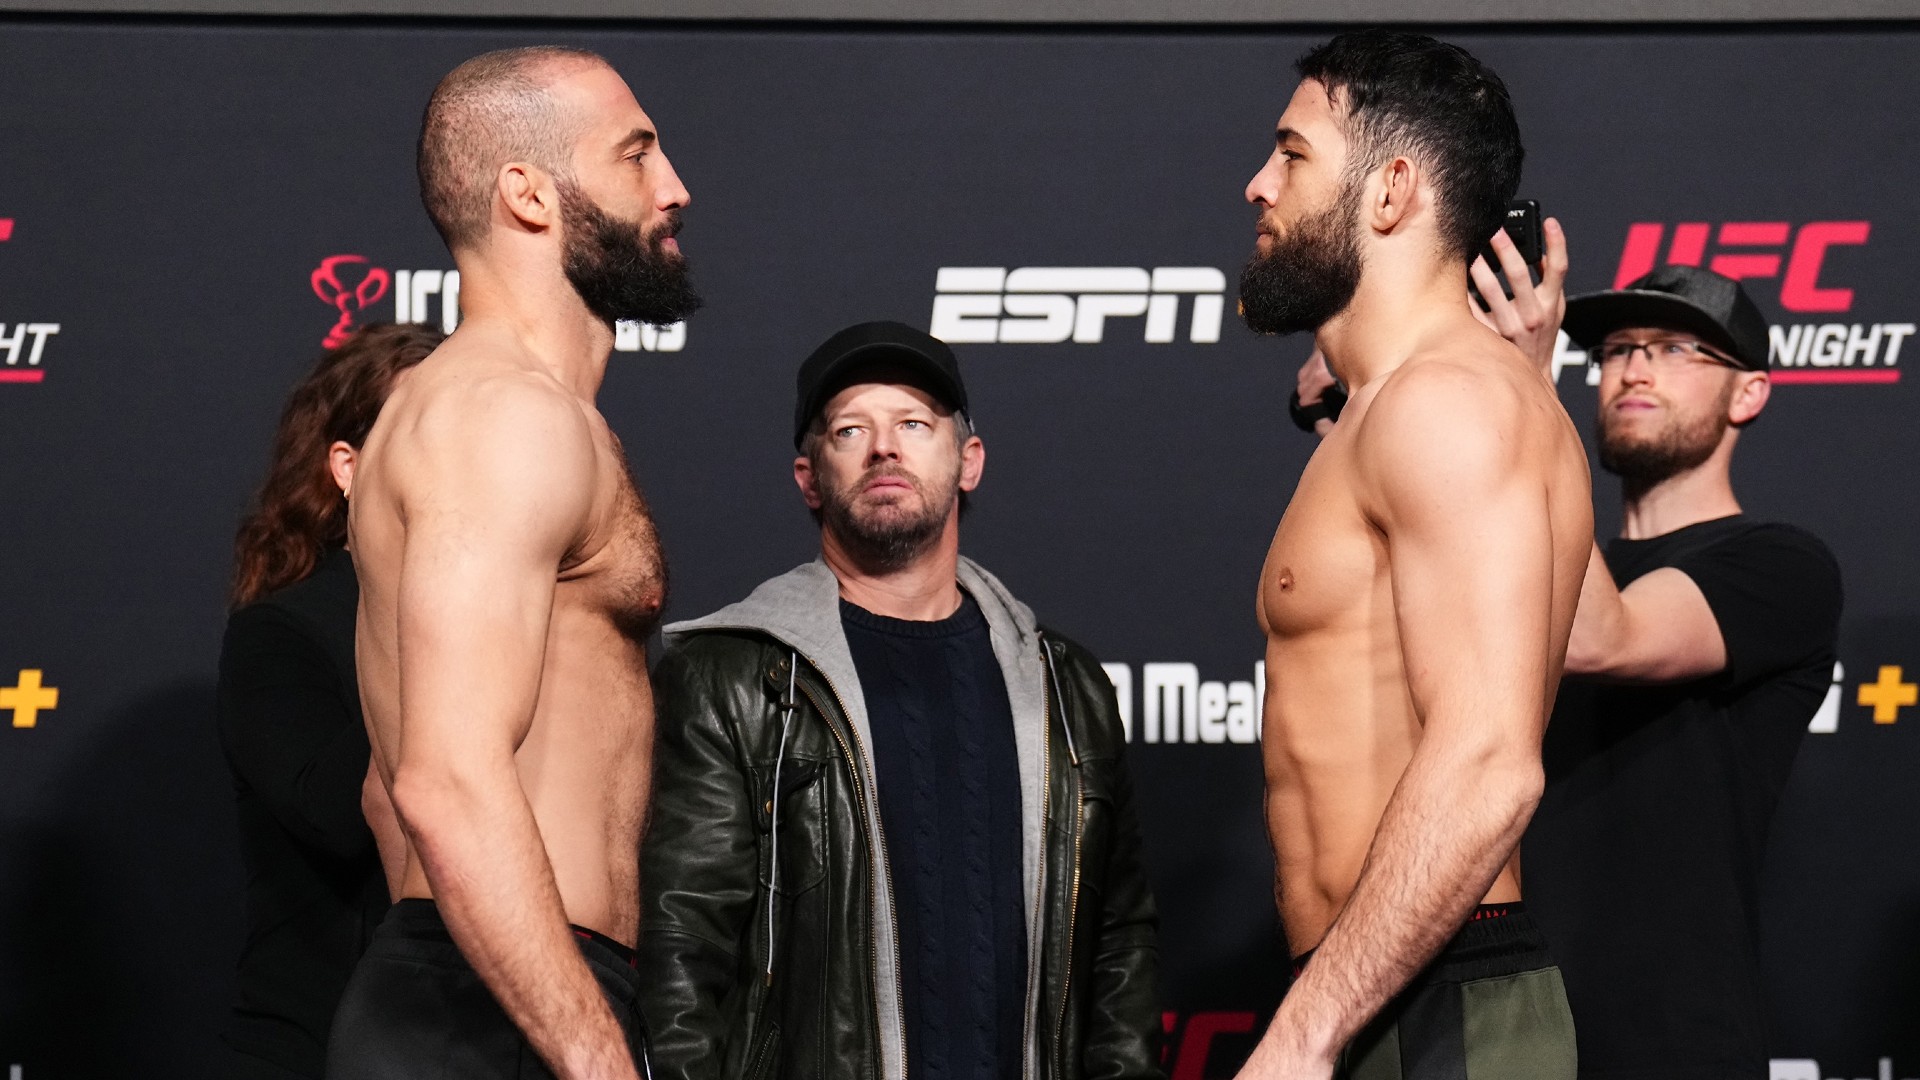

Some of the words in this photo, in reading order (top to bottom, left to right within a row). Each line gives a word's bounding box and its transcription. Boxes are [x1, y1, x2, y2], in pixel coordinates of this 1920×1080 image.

[1507, 209, 1525, 218] NY
[1614, 221, 1871, 312] UFC
[929, 266, 1227, 343] ESPN
[1768, 322, 1917, 367] NIGHT
